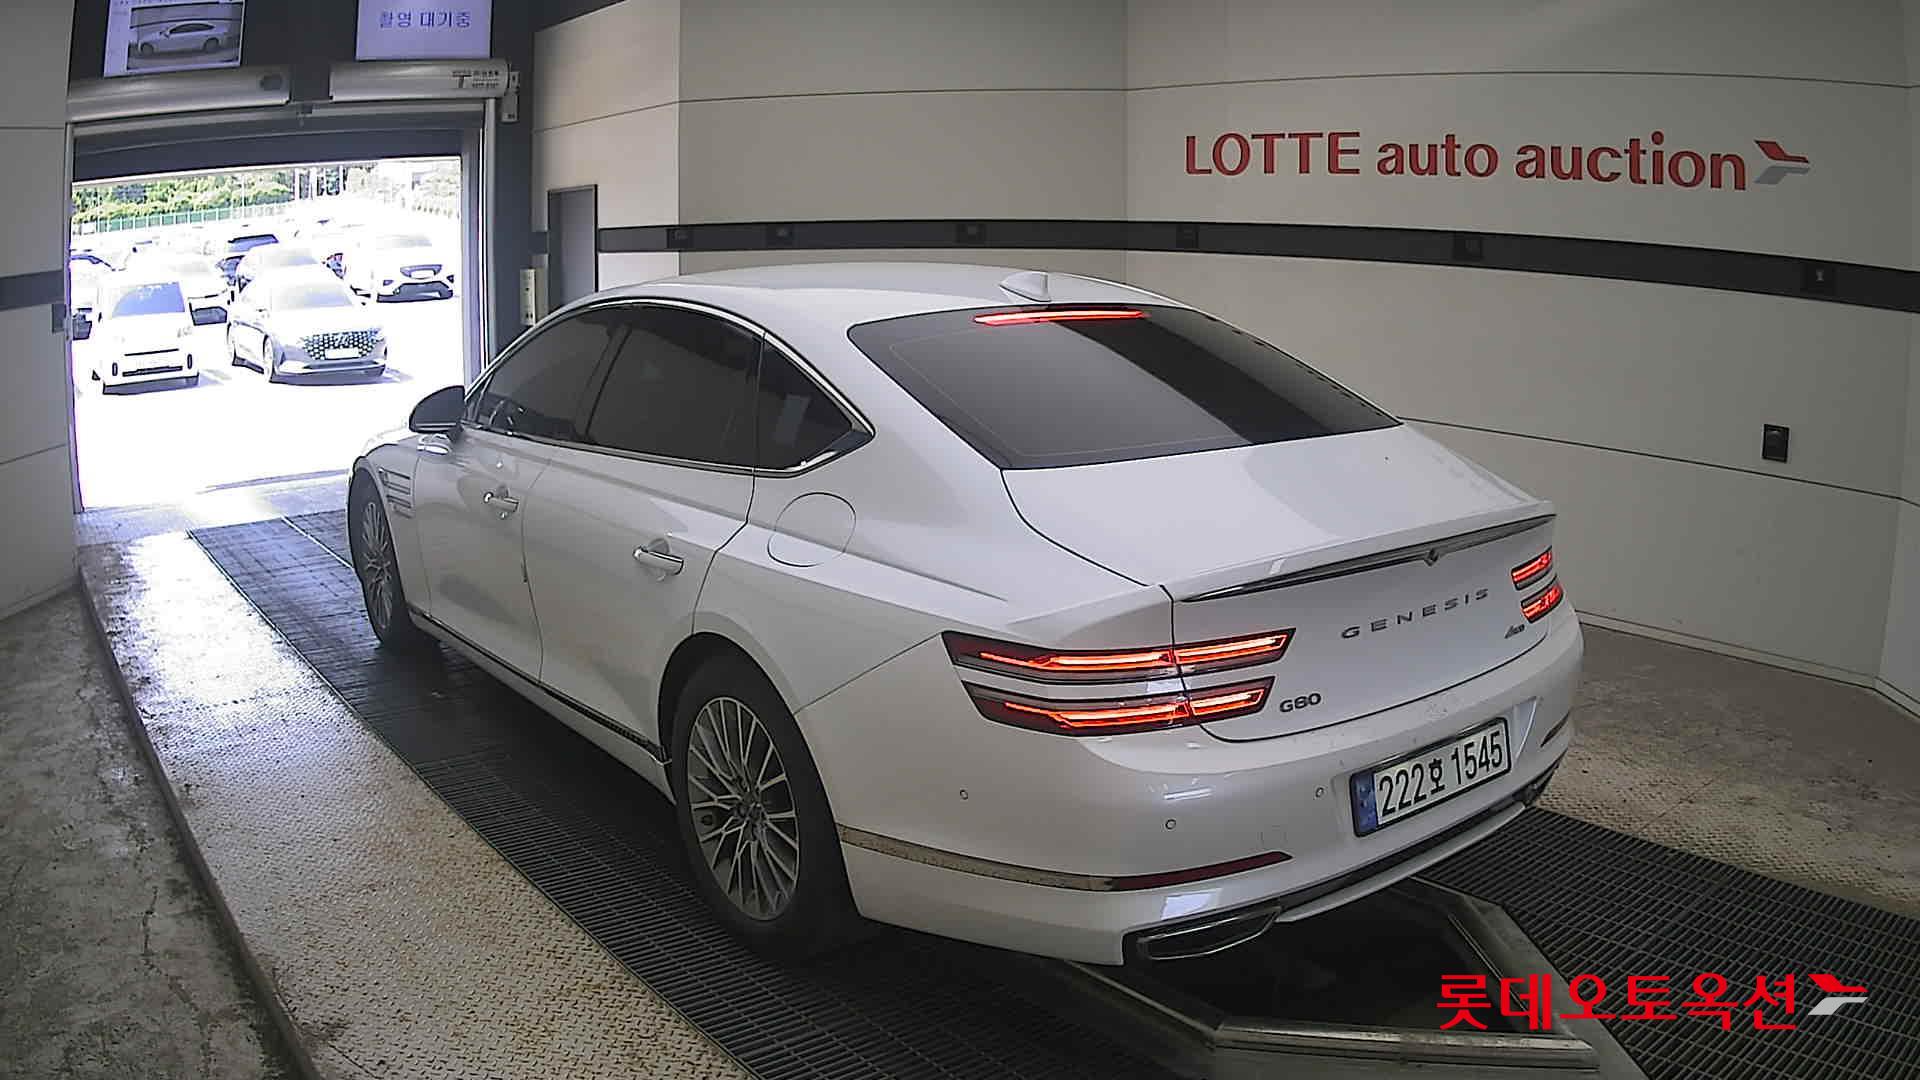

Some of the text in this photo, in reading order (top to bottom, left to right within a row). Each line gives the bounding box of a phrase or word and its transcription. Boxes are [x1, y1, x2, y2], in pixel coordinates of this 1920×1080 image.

[420, 11, 470, 28] 대기중
[1185, 131, 1747, 190] LOTTE auto auction
[1340, 588, 1489, 639] GENESIS
[1279, 692, 1322, 713] G80
[1379, 730, 1503, 817] 222호 1545
